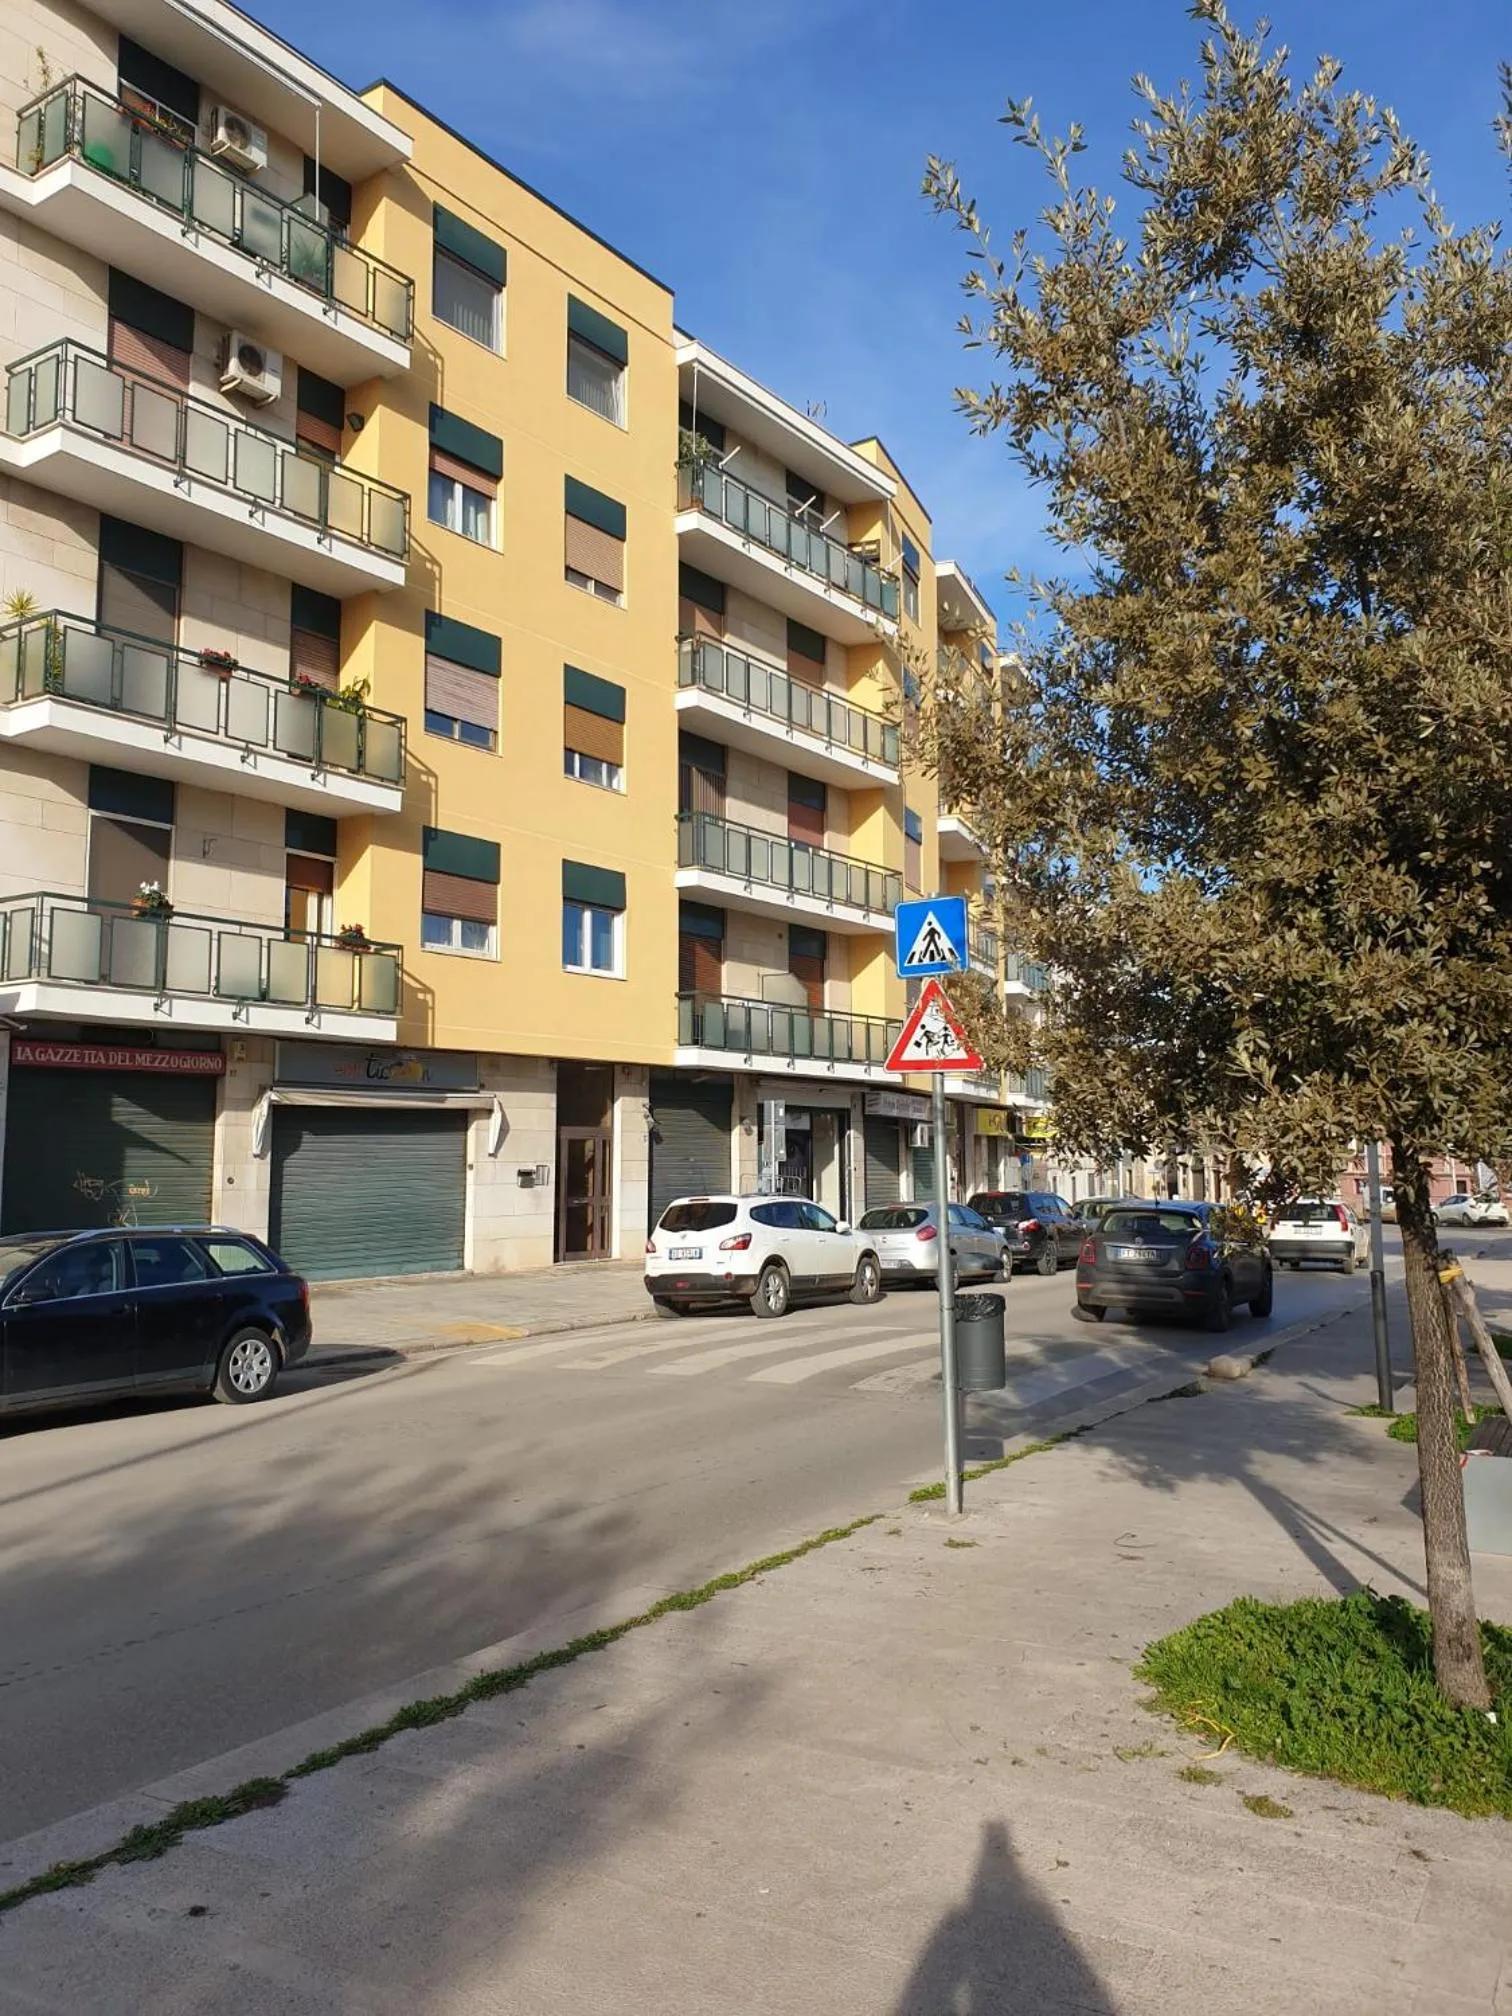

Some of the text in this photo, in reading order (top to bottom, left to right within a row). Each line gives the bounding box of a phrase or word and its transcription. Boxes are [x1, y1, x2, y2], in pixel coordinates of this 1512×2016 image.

[35, 1047, 105, 1064] GAZZETTA
[109, 1051, 134, 1065] DEL
[135, 1052, 223, 1070] MEZZOGIORNO
